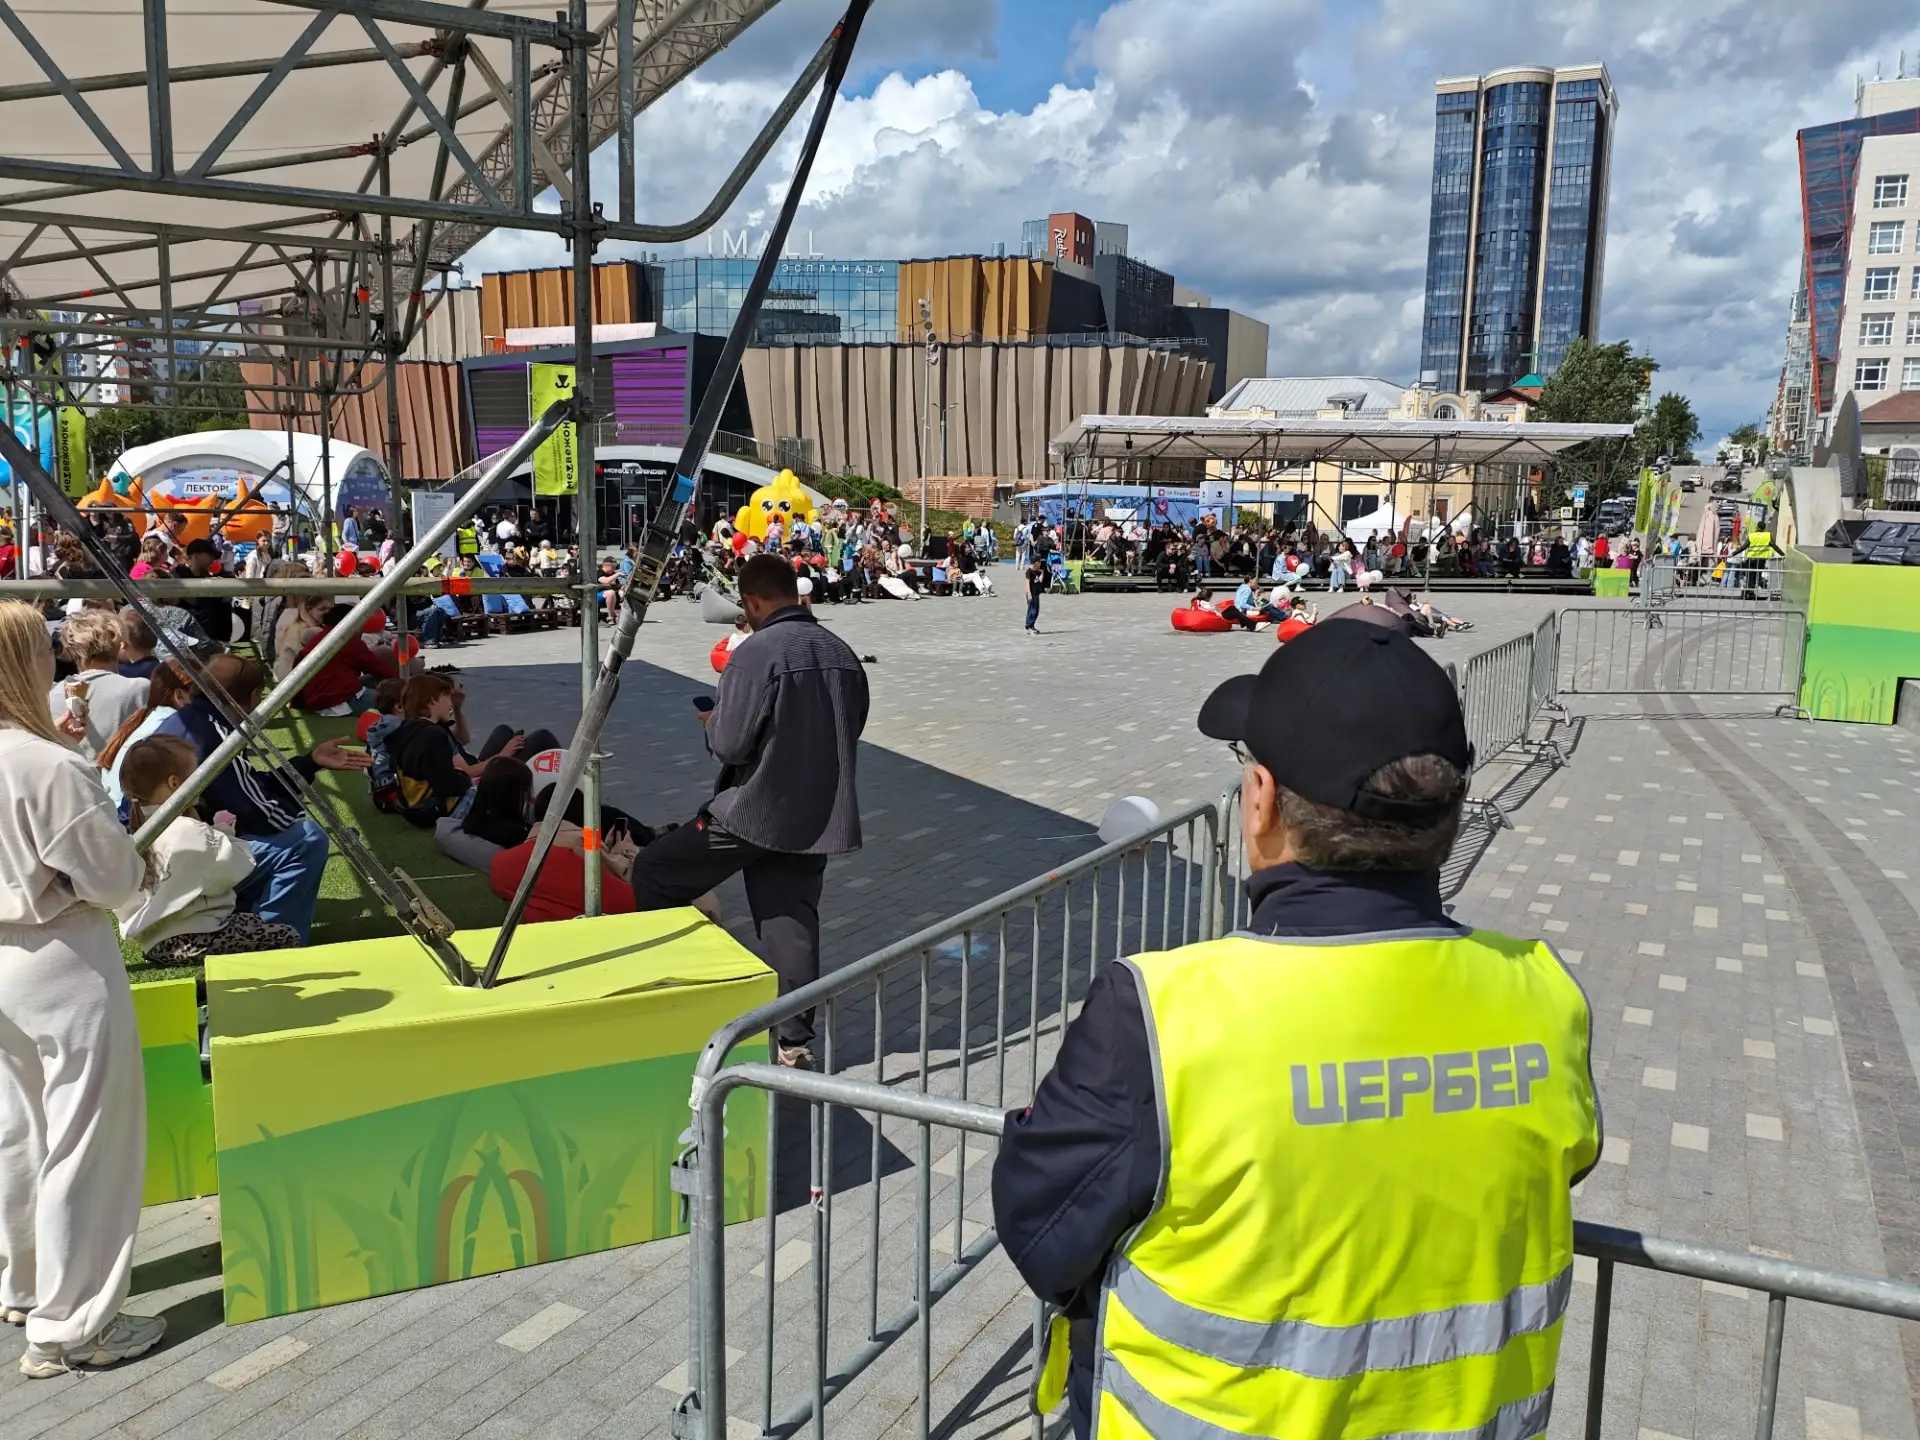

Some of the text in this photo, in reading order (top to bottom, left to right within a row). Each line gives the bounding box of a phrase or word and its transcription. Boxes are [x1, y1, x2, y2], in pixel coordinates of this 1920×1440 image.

[782, 264, 885, 274] ЭСПЛАНАДА
[563, 421, 574, 490] медвежон
[1290, 1043, 1549, 1126] ЦЕРБЕР
